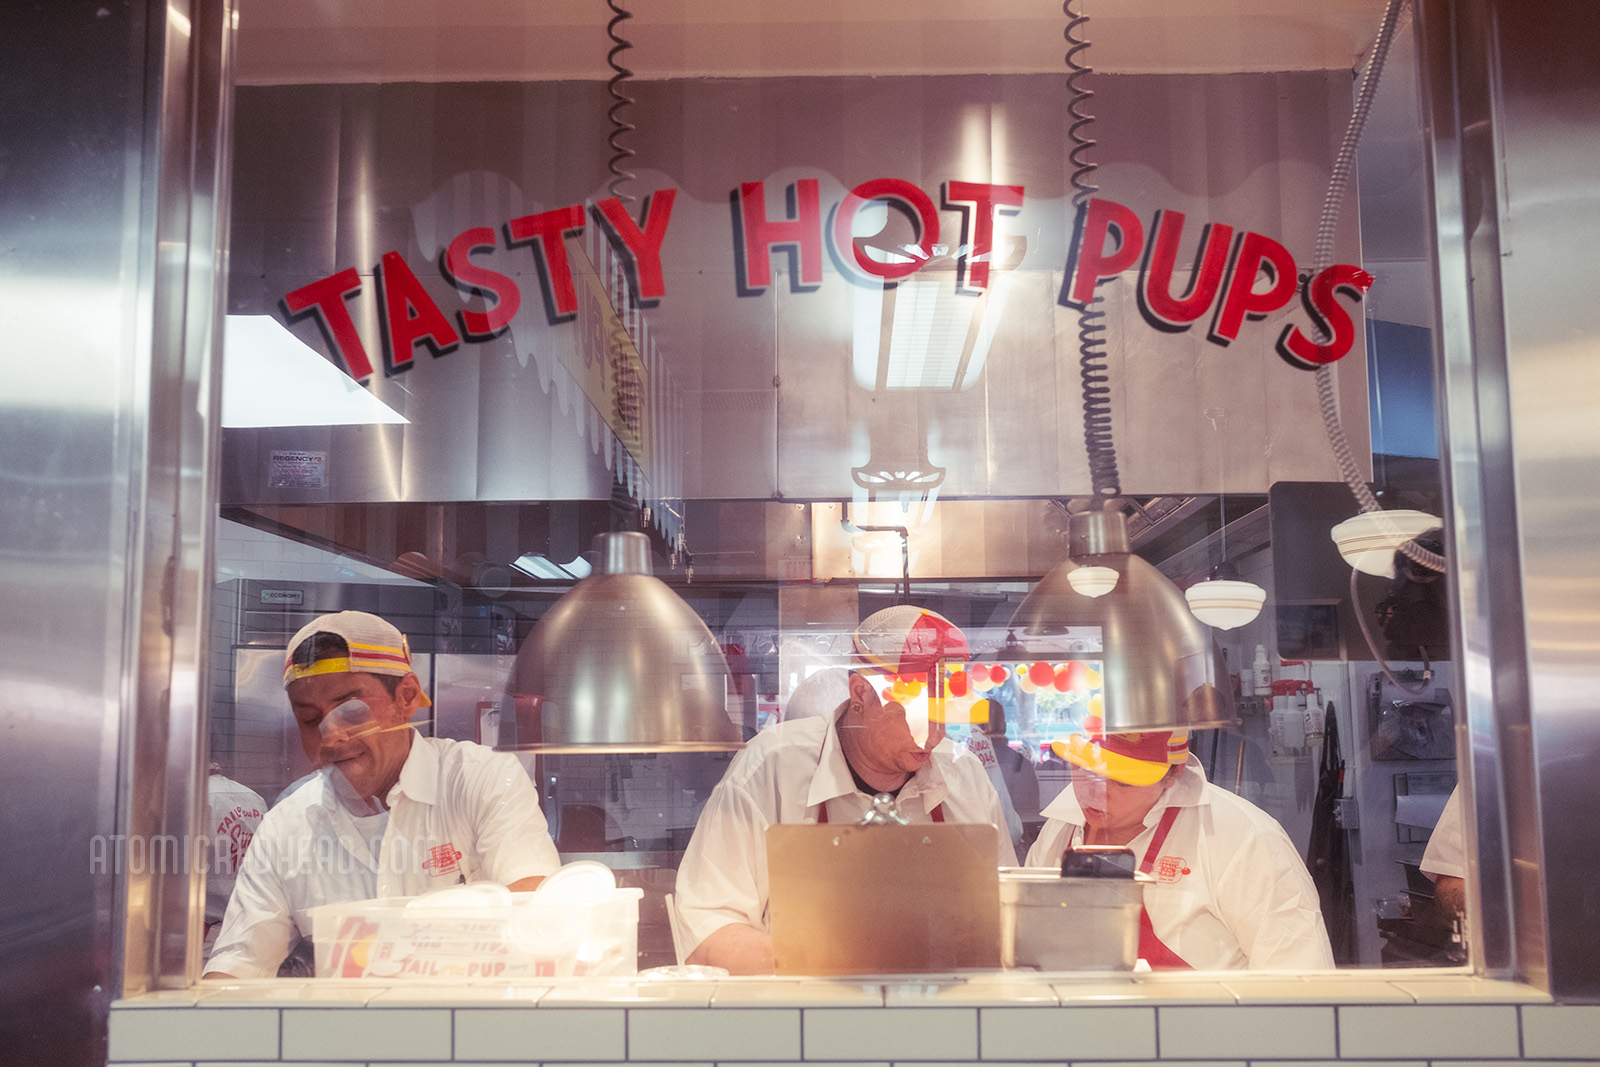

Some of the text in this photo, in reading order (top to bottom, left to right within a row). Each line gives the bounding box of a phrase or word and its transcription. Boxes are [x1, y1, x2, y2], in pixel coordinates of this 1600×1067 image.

[279, 177, 1375, 387] TASTY HOT PUPS
[216, 808, 242, 835] TAIL
[399, 956, 439, 977] TAIL
[466, 960, 506, 978] PUP
